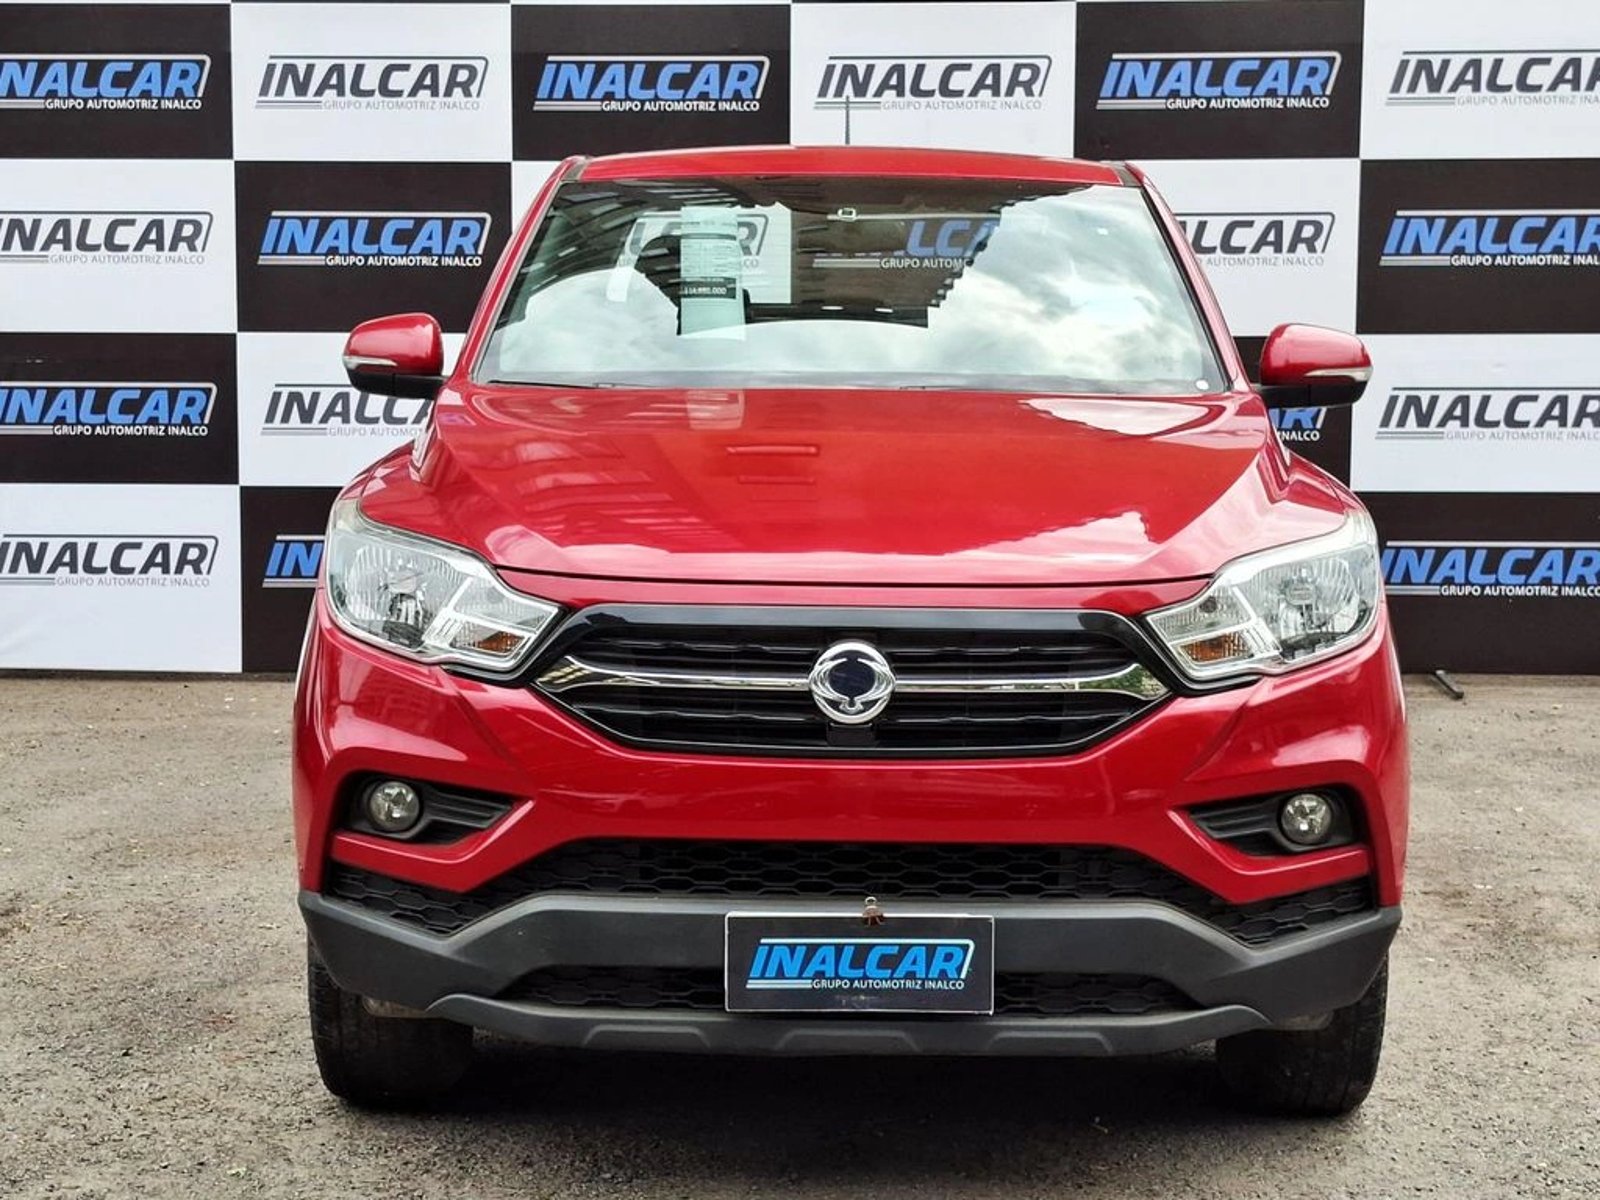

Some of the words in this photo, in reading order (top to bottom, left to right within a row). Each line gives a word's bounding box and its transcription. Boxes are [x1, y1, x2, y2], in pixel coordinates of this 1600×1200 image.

[258, 63, 478, 98] INALCAR
[536, 63, 760, 99] INALCAR
[817, 63, 1041, 98] INALCAR
[1099, 59, 1330, 97] INALCAR
[45, 99, 84, 110] GRUPO
[87, 99, 158, 110] AUTOMOTRIZ
[161, 99, 202, 110] INALCO
[323, 101, 362, 110] GRUPO
[365, 101, 436, 110] AUTOMOTRIZ
[439, 101, 480, 111] INALCO
[602, 101, 641, 111] GRUPO
[644, 101, 716, 111] AUTOMOTRIZ
[718, 101, 760, 111] INALCO
[882, 101, 922, 110] GRUPO
[924, 101, 997, 110] AUTOMOTRIZ
[1000, 100, 1042, 110] INALCO
[1166, 98, 1206, 109] GRUPO
[1209, 97, 1283, 108] AUTOMOTRIZ
[1287, 97, 1329, 108] INALCO
[1457, 95, 1495, 106] GRUPO
[261, 218, 481, 255] INALCAR
[50, 254, 88, 264] GRUPO
[91, 254, 162, 265] AUTOMOTRIZ
[165, 255, 205, 265] INALCO
[326, 256, 364, 266] GRUPO
[367, 256, 438, 267] AUTOMOTRIZ
[441, 257, 482, 267] INALCO
[881, 258, 920, 269] GRUPO
[1206, 257, 1279, 267] AUTOMOTRIZ
[1282, 256, 1325, 266] INALCO
[1451, 255, 1492, 266] GRUPO
[1494, 255, 1570, 266] AUTOMOTRIZ
[1379, 395, 1600, 428] INALCAR
[54, 426, 92, 436] GRUPO
[94, 426, 165, 436] AUTOMOTRIZ
[168, 426, 208, 436] INALCO
[329, 427, 365, 437] GRUPO
[1446, 431, 1486, 441] GRUPO
[1489, 431, 1564, 441] AUTOMOTRIZ
[1380, 548, 1600, 585] INALCAR
[56, 578, 94, 587] GRUPO
[97, 578, 166, 588] AUTOMOTRIZ
[169, 578, 210, 588] INALCO
[1440, 585, 1481, 596] GRUPO
[1484, 585, 1558, 596] AUTOMOTRIZ
[750, 945, 965, 979] INALCAR
[813, 979, 850, 989] GRUPO
[853, 979, 922, 989] AUTOMOTRIZ
[925, 980, 965, 990] INALCO
